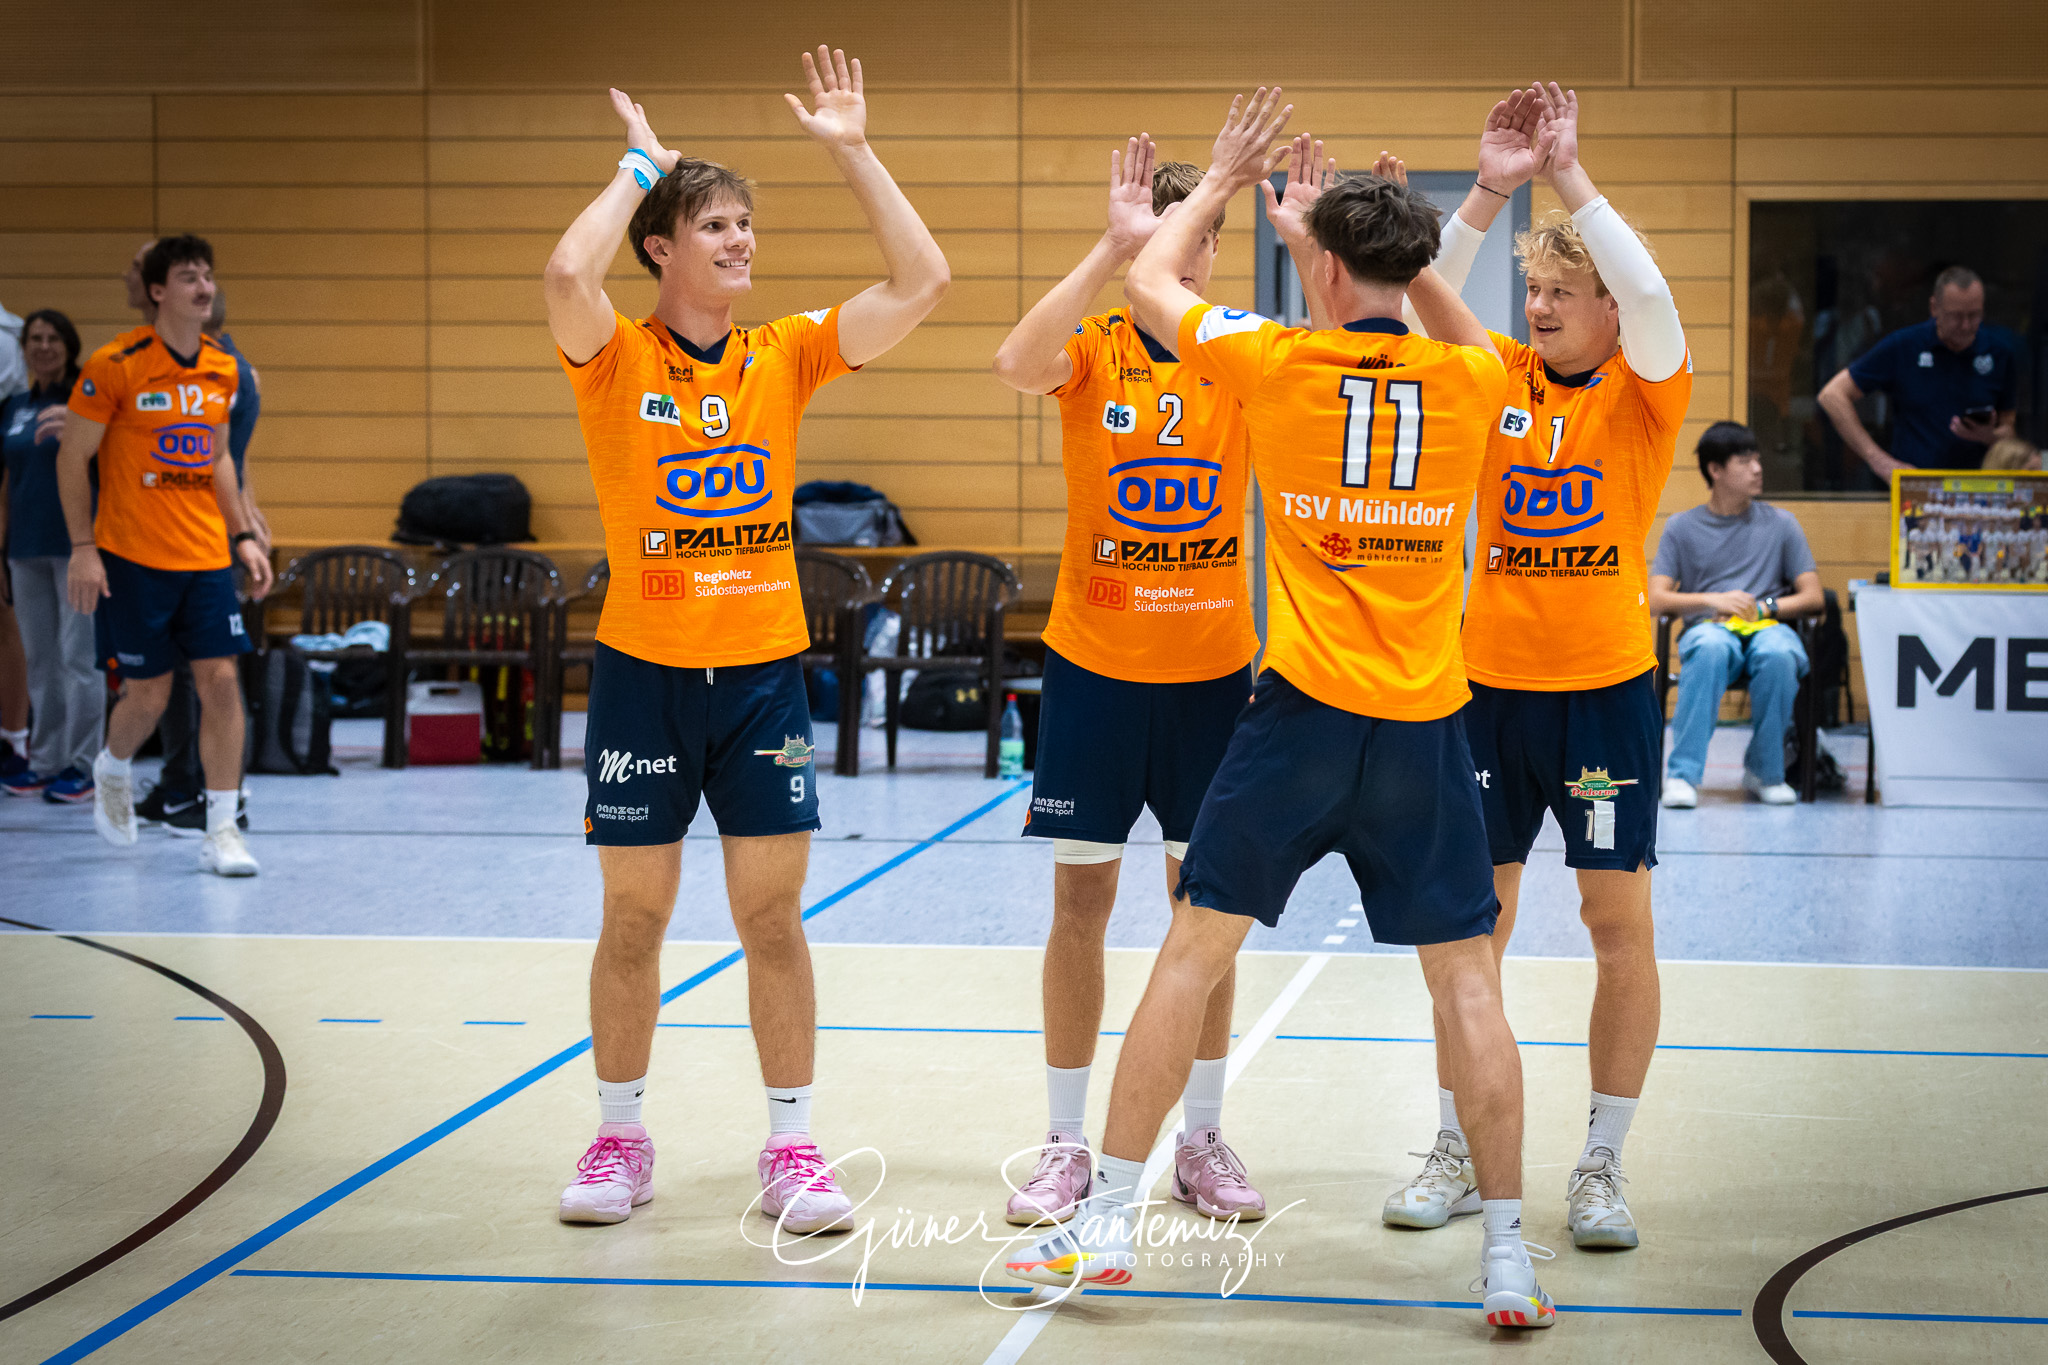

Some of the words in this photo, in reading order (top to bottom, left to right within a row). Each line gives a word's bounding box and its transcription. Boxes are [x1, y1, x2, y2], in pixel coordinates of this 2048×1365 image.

[177, 384, 205, 417] 12
[700, 394, 730, 439] 9
[1157, 392, 1184, 446] 2
[1338, 374, 1424, 491] 11
[1547, 416, 1566, 464] 1
[157, 433, 212, 456] ODU
[666, 459, 765, 500] ODU
[1117, 475, 1219, 512] ODU
[1503, 480, 1593, 517] ODU
[1280, 491, 1332, 521] TSV
[1338, 498, 1456, 527] Mühldorf
[674, 521, 790, 550] PALITZA
[1358, 537, 1444, 553] STADTWERKE
[676, 550, 707, 559] HOCH
[709, 548, 733, 558] UND
[735, 545, 765, 556] TIEFBAU
[766, 542, 792, 553] GmbH
[1121, 536, 1238, 563] PALITZA
[1357, 553, 1410, 563] mühldorf
[1506, 545, 1619, 568] PALITZA
[694, 569, 752, 585] RegioNetz
[1122, 562, 1150, 572] HOCH
[1153, 563, 1176, 572] UND
[1211, 559, 1238, 569] GmbH
[1525, 568, 1548, 578] UND
[1550, 568, 1589, 578] TIEFBAU
[1592, 567, 1620, 577] GmbH
[646, 574, 681, 596] DB
[695, 579, 792, 598] Südostbayernbahn
[1092, 580, 1123, 606] DB
[1134, 586, 1195, 600] RegioNetz
[1133, 597, 1235, 614] Südostbayernbahn
[790, 775, 805, 803] 9
[1570, 786, 1619, 797] Palermo
[597, 803, 649, 815] panzeri
[627, 814, 649, 823] sport
[1046, 806, 1054, 814] lo
[1054, 808, 1074, 817] sport
